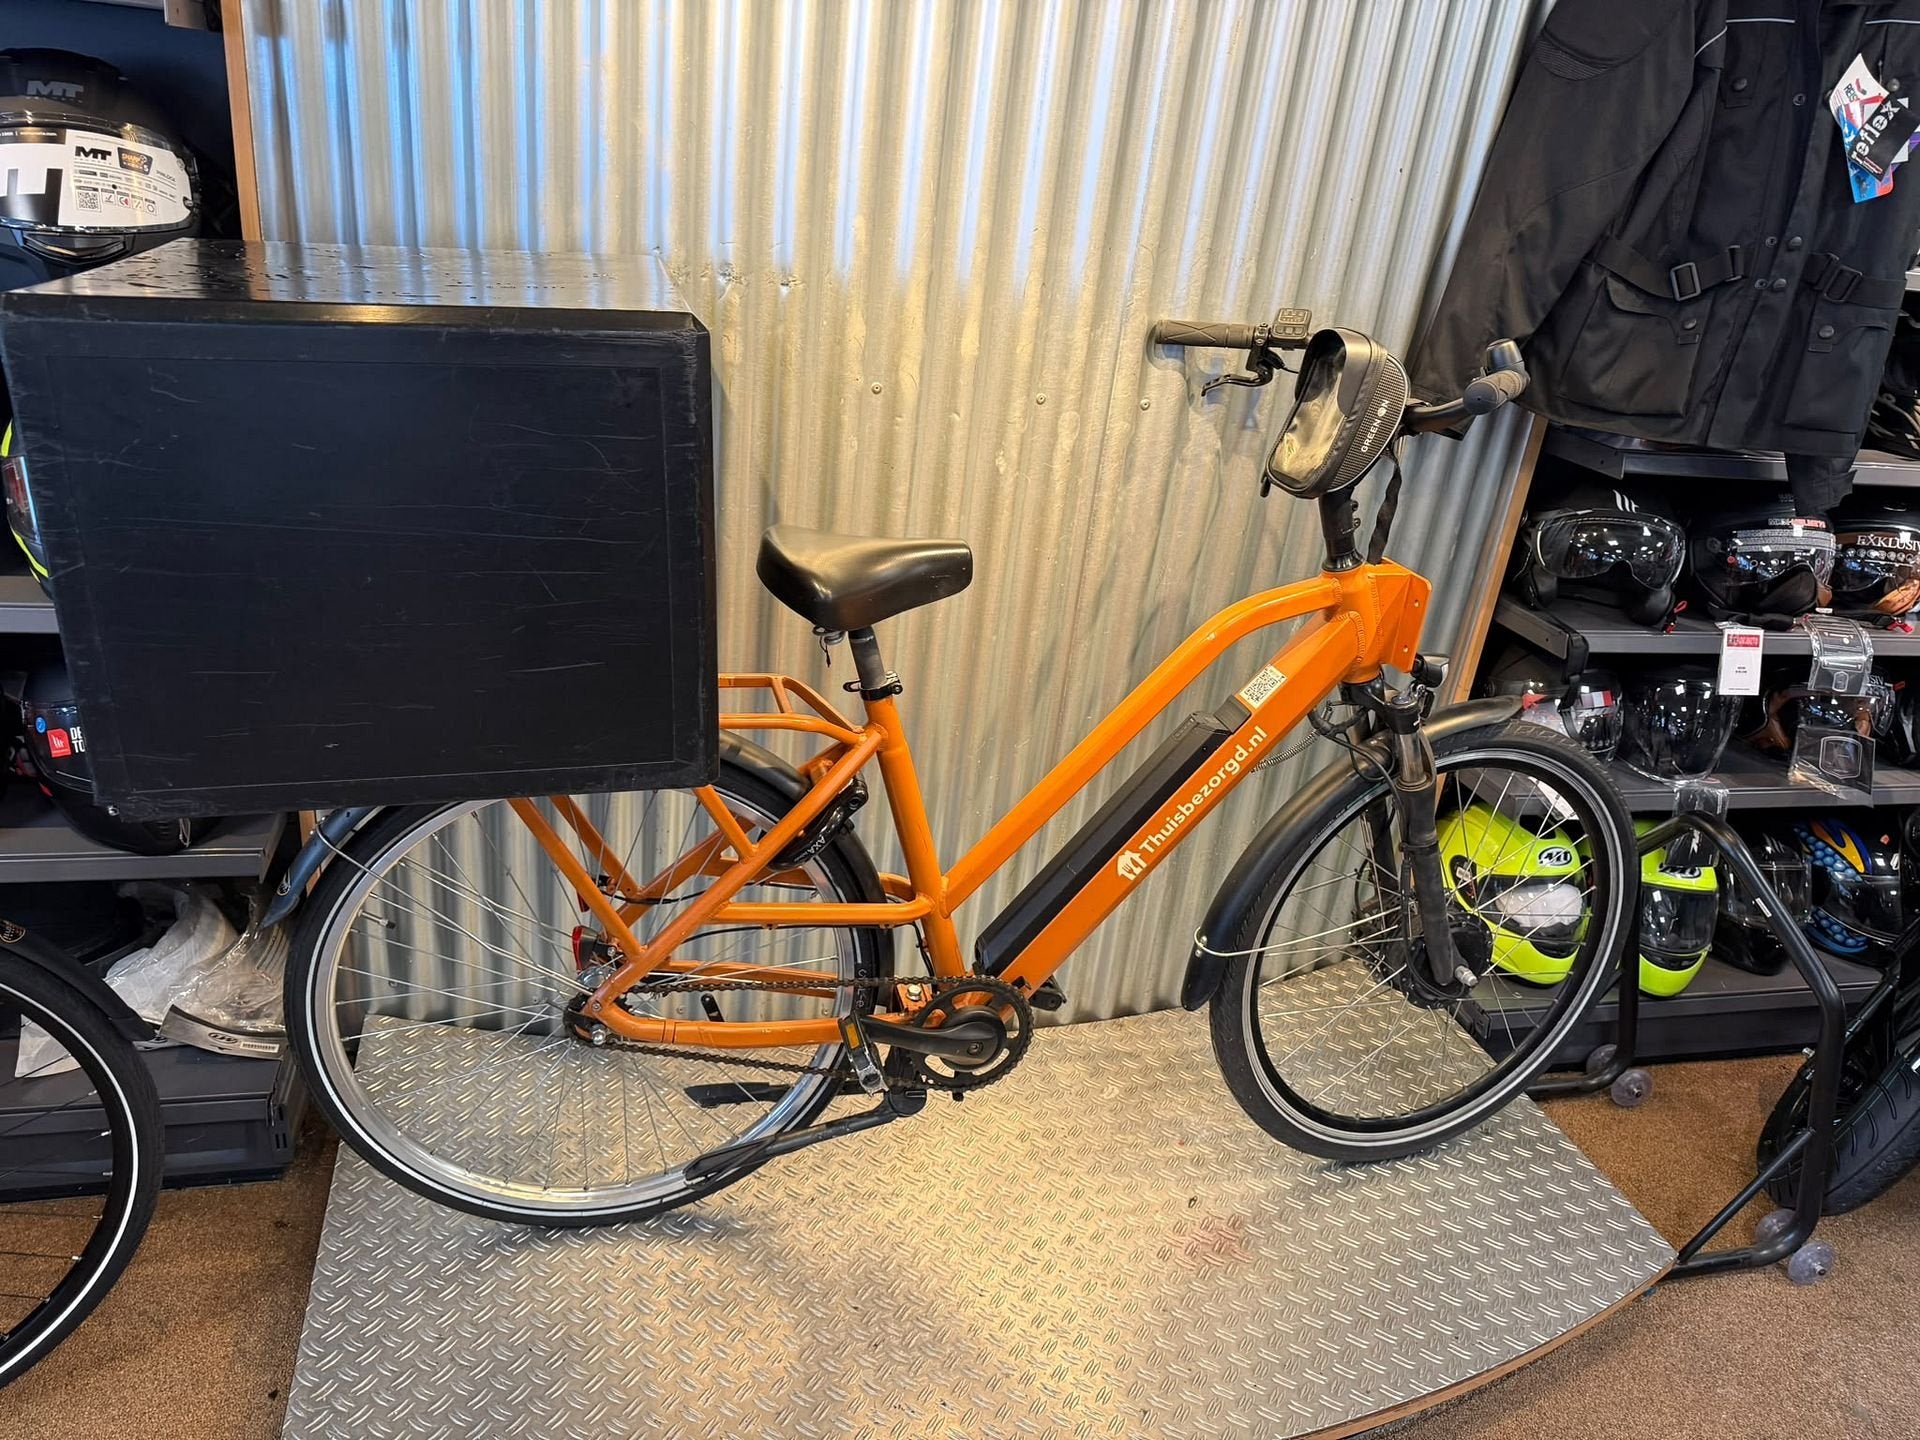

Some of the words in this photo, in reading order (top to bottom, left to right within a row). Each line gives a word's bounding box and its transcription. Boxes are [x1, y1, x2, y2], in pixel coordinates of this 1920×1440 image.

[26, 80, 84, 98] MT
[1851, 101, 1900, 164] reflex
[75, 146, 112, 160] MT
[1360, 418, 1381, 453] GREEN
[1139, 725, 1268, 854] Thuisbezorgd.nl
